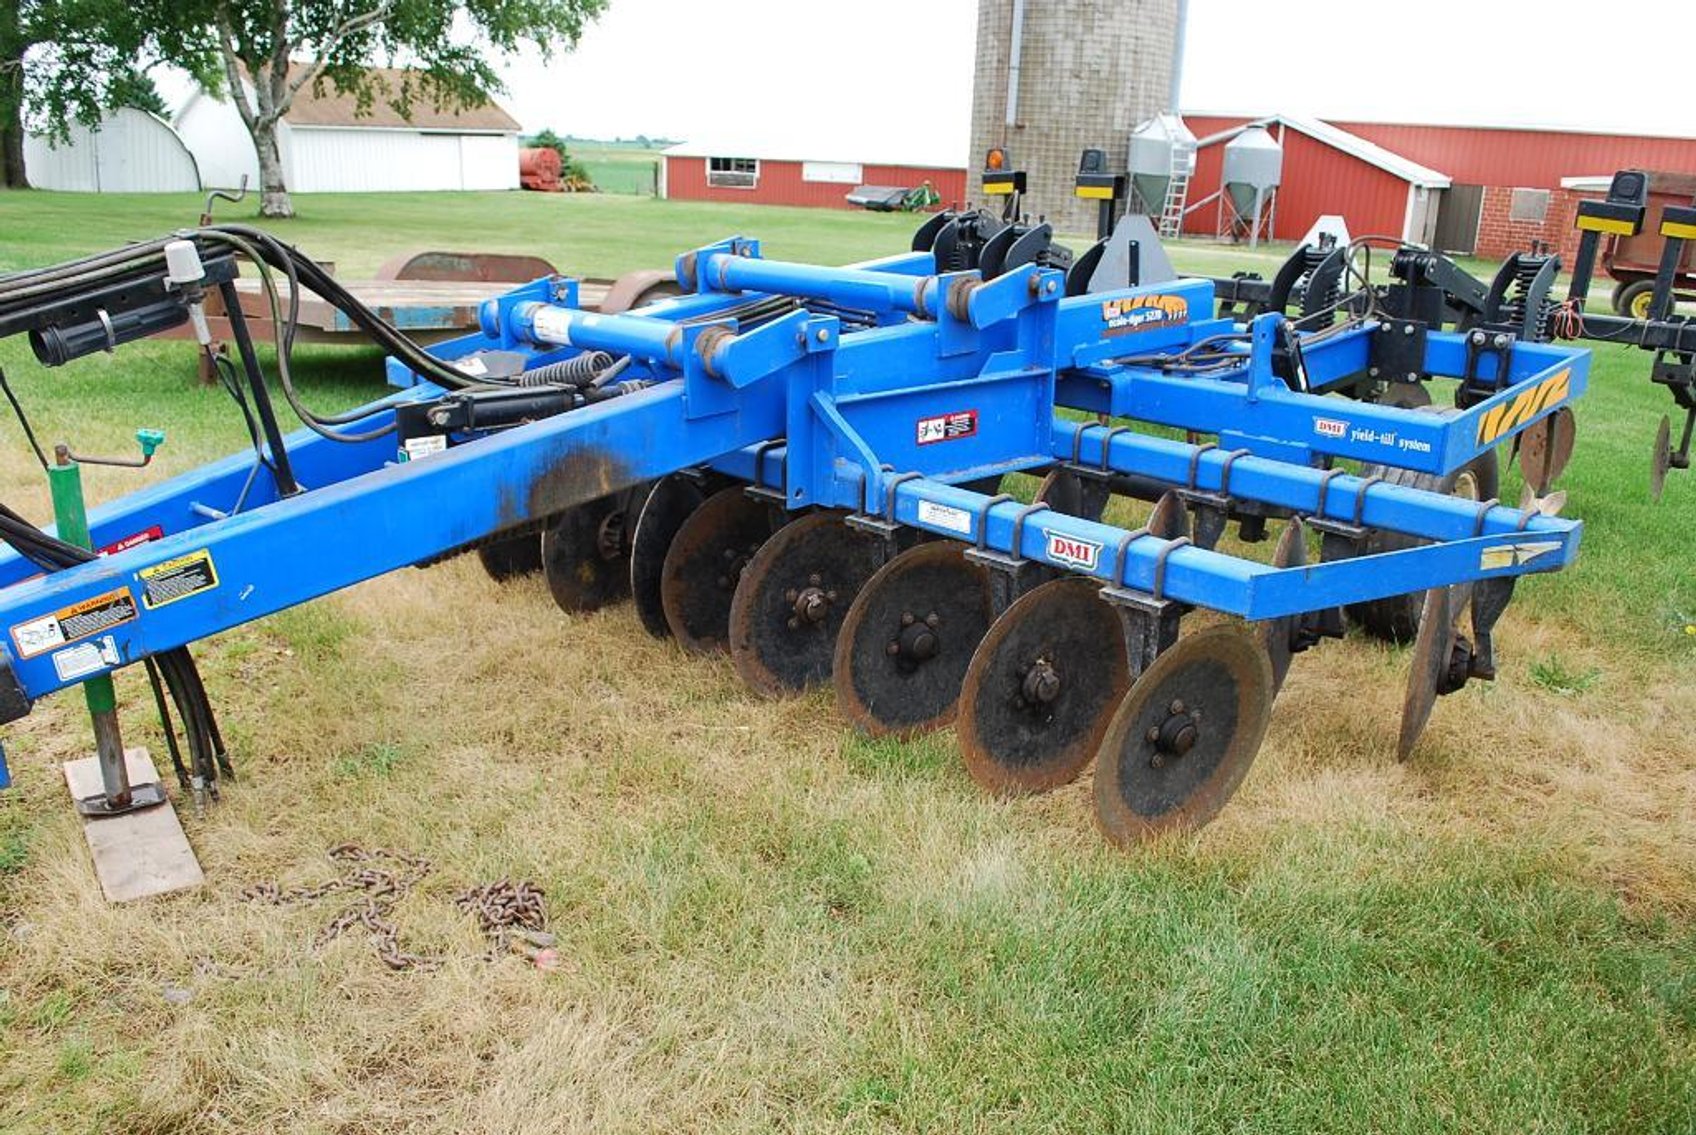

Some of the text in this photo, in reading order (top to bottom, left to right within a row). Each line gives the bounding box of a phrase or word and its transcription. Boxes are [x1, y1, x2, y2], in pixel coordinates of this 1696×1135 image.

[1319, 421, 1341, 434] DMI
[1399, 438, 1431, 453] system
[1053, 539, 1091, 562] DMI
